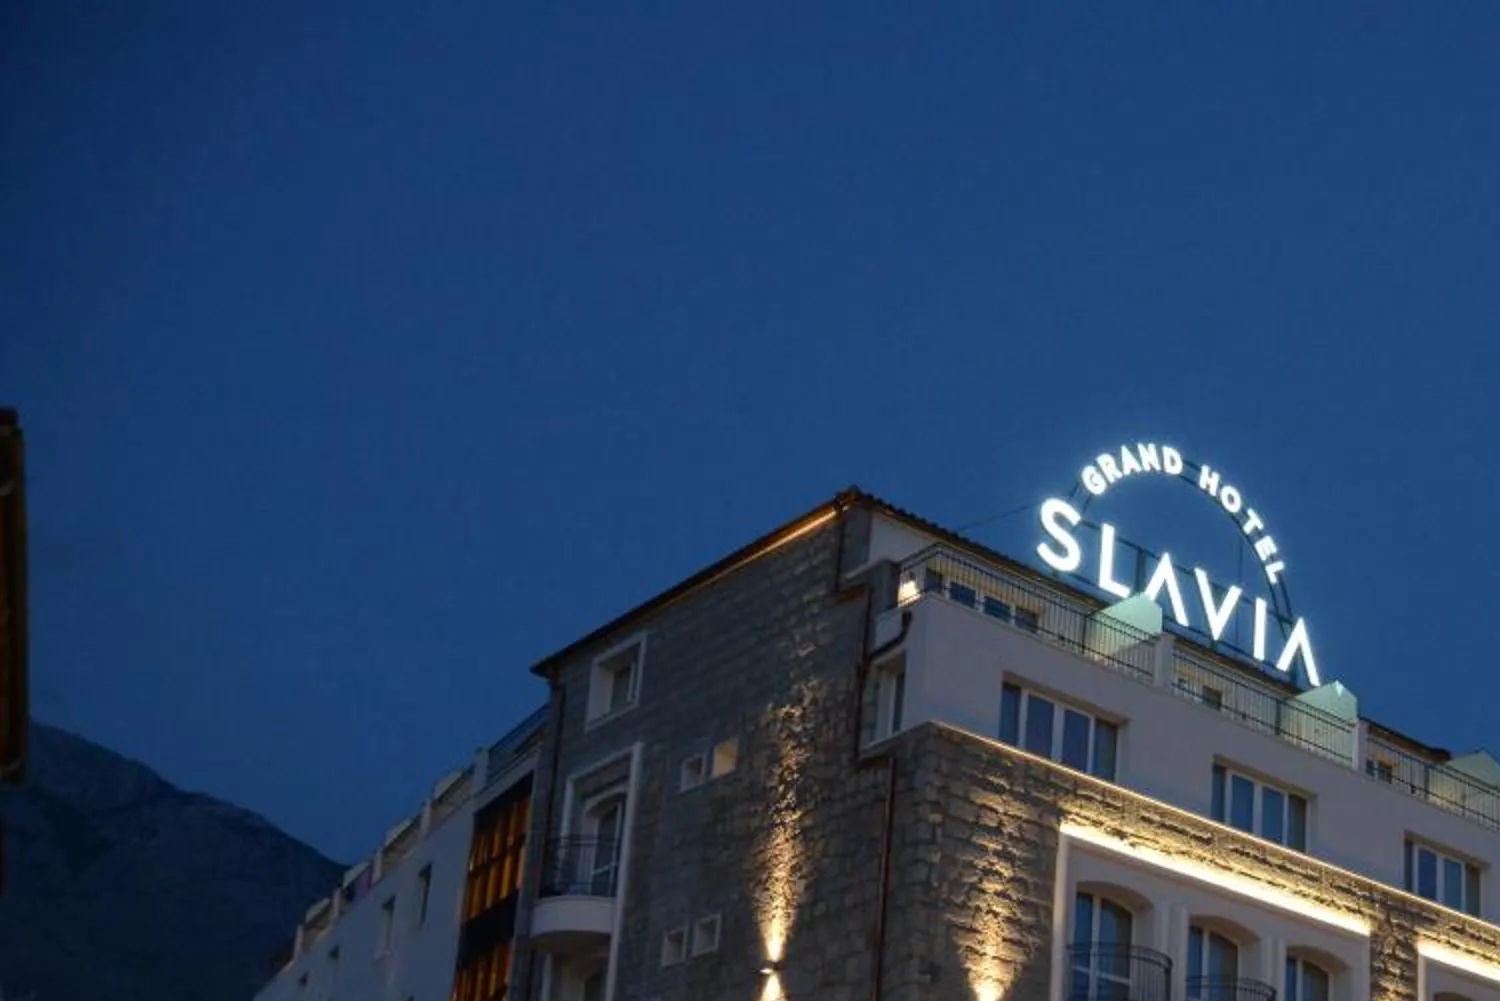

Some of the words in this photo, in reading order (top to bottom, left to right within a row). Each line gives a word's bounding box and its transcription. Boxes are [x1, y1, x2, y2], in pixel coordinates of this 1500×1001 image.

[1036, 498, 1321, 687] SLAVIA
[1081, 443, 1183, 495] GRAND
[1199, 464, 1285, 584] HOTEL
